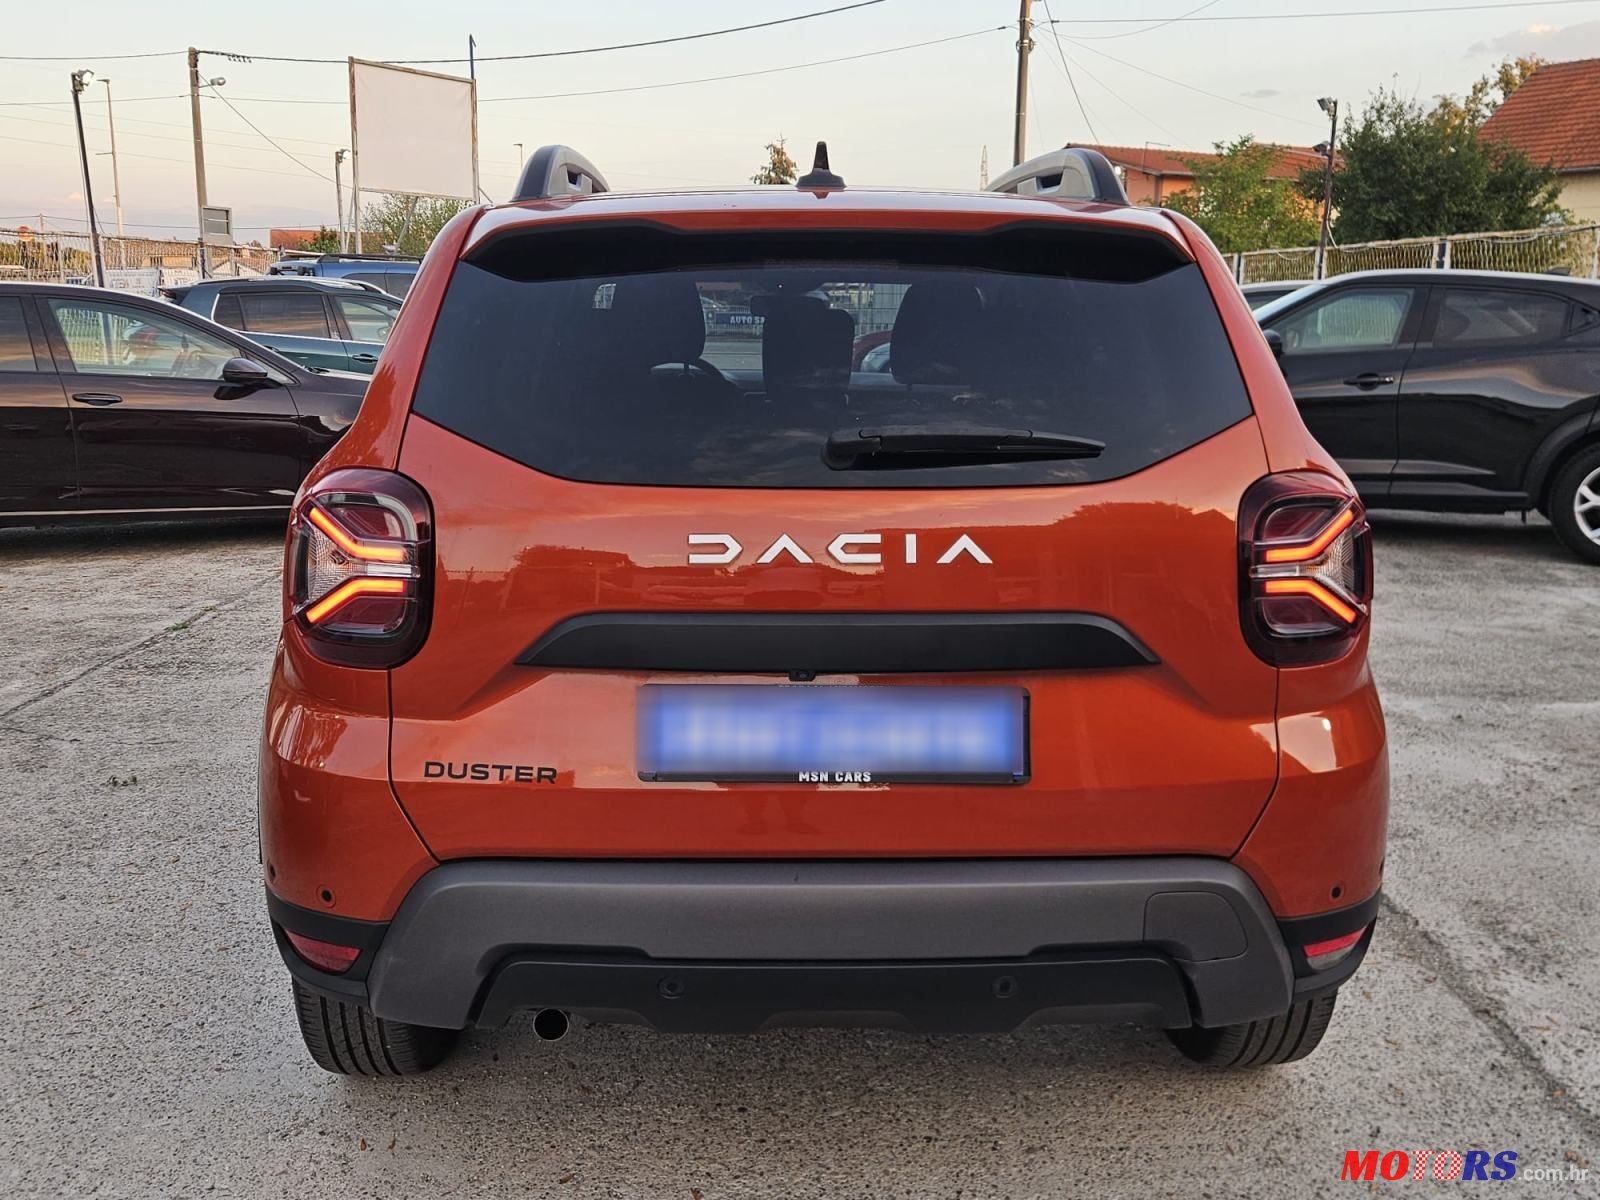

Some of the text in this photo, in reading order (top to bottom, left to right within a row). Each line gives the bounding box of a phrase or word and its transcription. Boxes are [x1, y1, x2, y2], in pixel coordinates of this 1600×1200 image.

[688, 533, 993, 564] DACIA
[424, 761, 557, 784] DUSTER
[799, 771, 872, 782] MSN CARS
